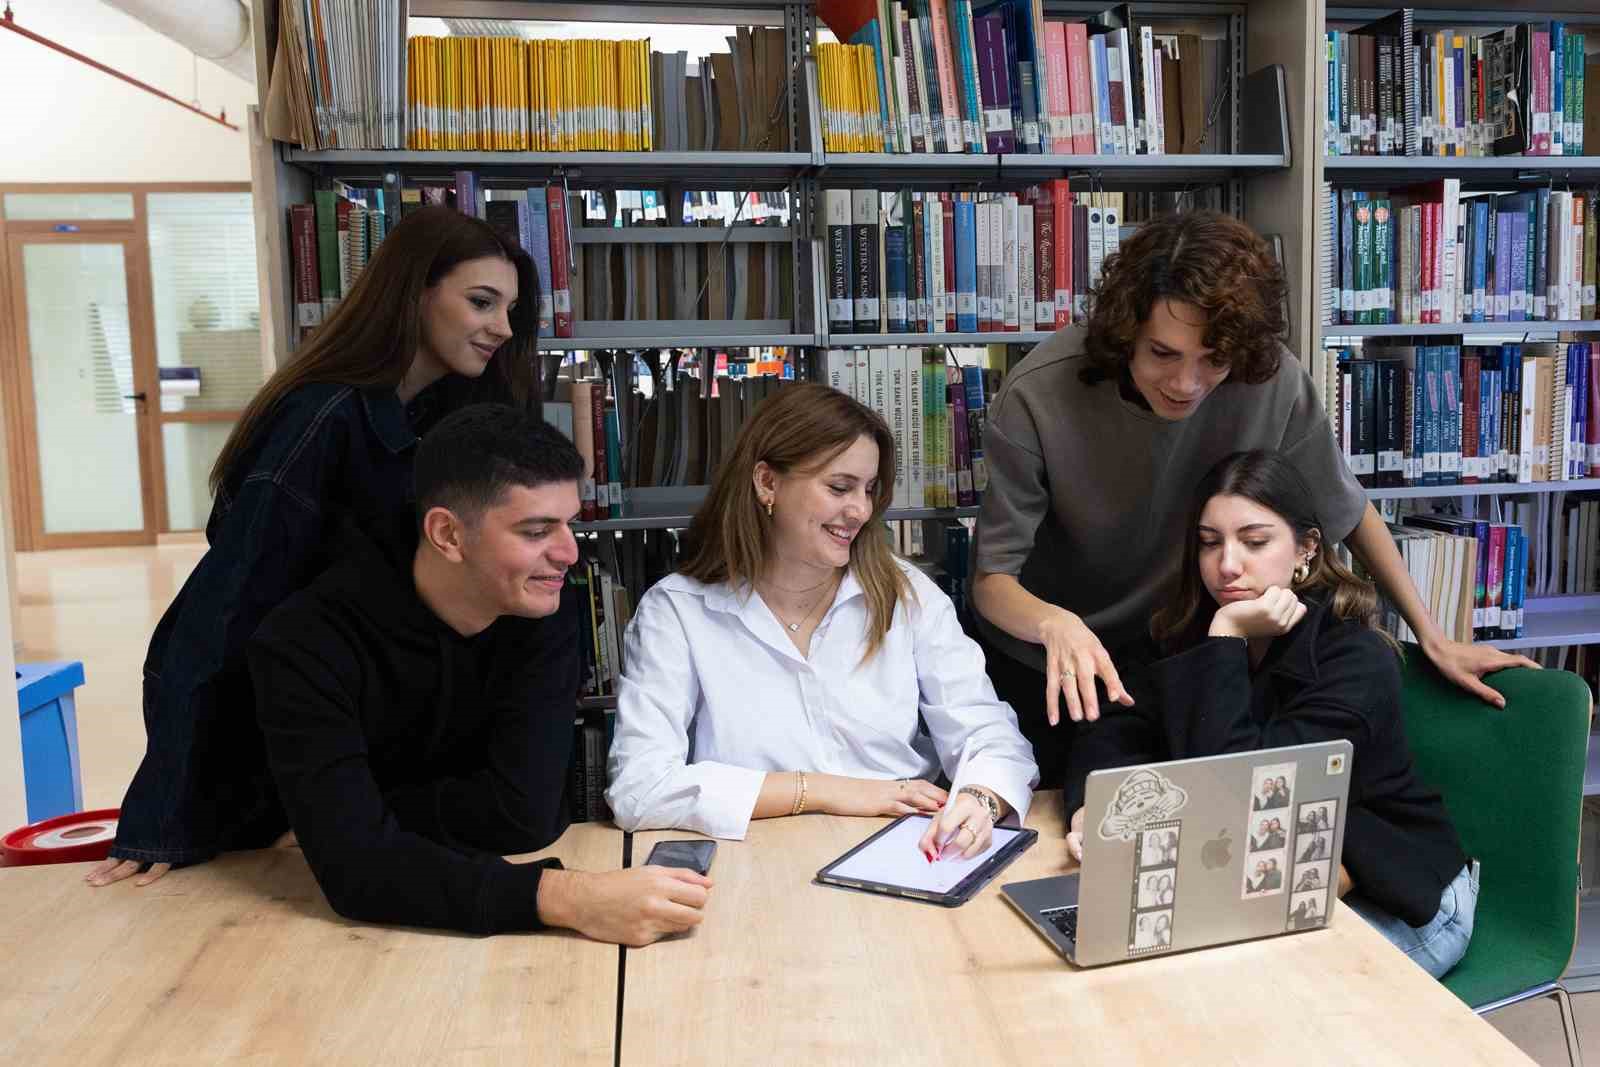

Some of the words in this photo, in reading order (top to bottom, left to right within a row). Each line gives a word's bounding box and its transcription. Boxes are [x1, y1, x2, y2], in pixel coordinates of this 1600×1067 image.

[834, 228, 844, 273] WESTERN
[858, 227, 868, 273] WESTERN
[834, 276, 844, 299] MUSI
[858, 274, 868, 299] MUSI
[911, 370, 919, 385] TÜRK
